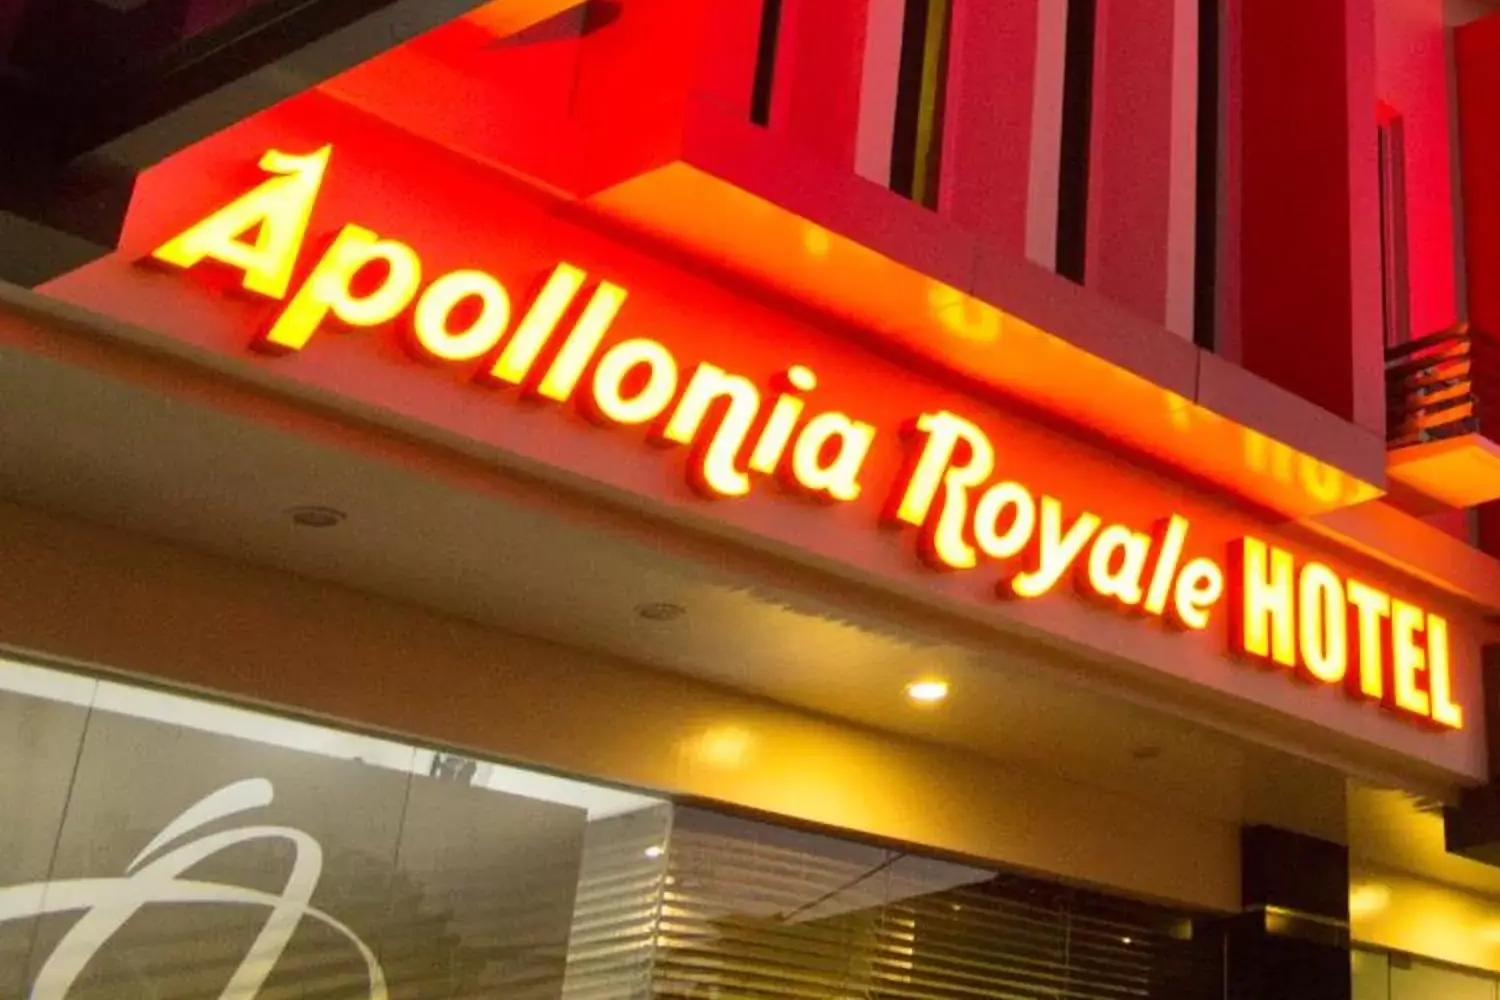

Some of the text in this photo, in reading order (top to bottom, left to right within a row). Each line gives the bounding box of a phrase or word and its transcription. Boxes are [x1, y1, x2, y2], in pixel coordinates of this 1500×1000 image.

[151, 143, 1463, 730] Apollonia Royale HOTEL
